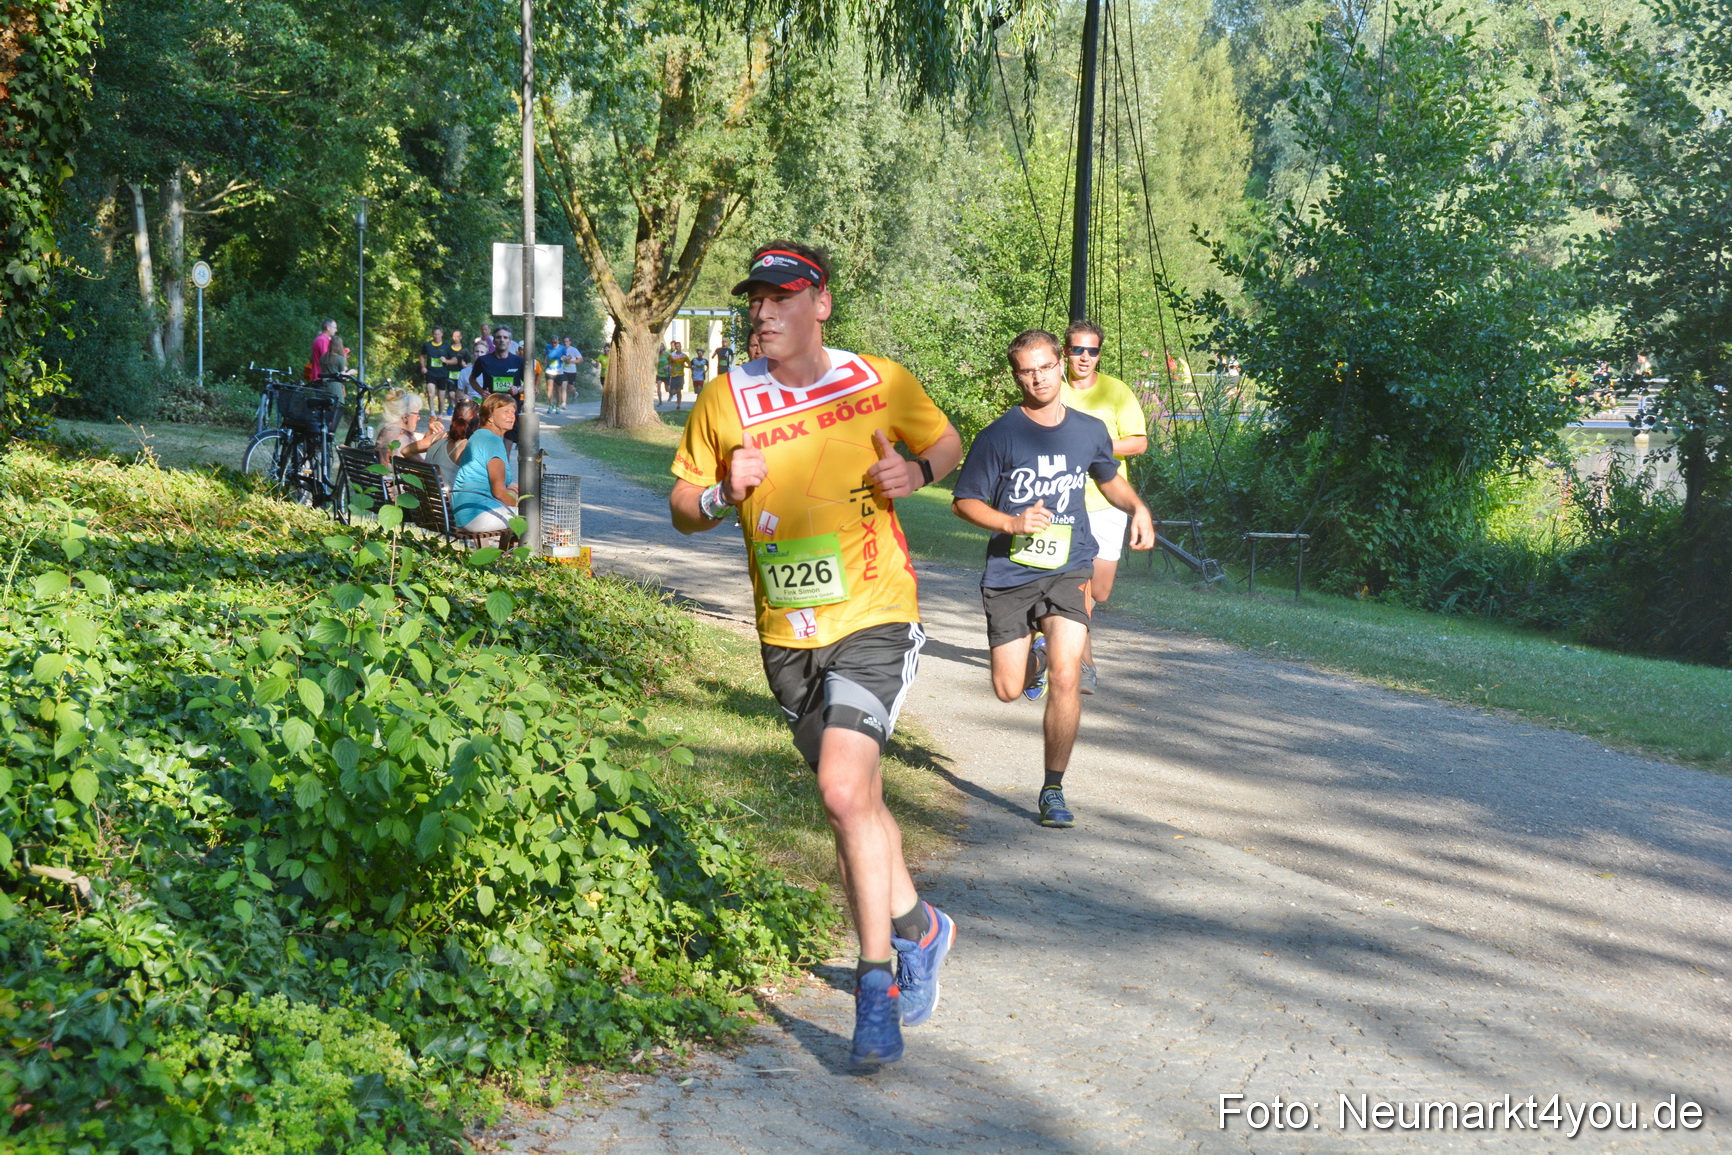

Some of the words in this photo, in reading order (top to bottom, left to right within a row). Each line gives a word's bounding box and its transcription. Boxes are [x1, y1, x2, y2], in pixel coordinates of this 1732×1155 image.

[750, 420, 809, 450] MAX
[816, 394, 887, 430] BÖGL
[1009, 465, 1084, 514] Burgis
[1023, 536, 1057, 556] 295
[768, 560, 832, 589] 1226
[798, 587, 820, 595] Simon
